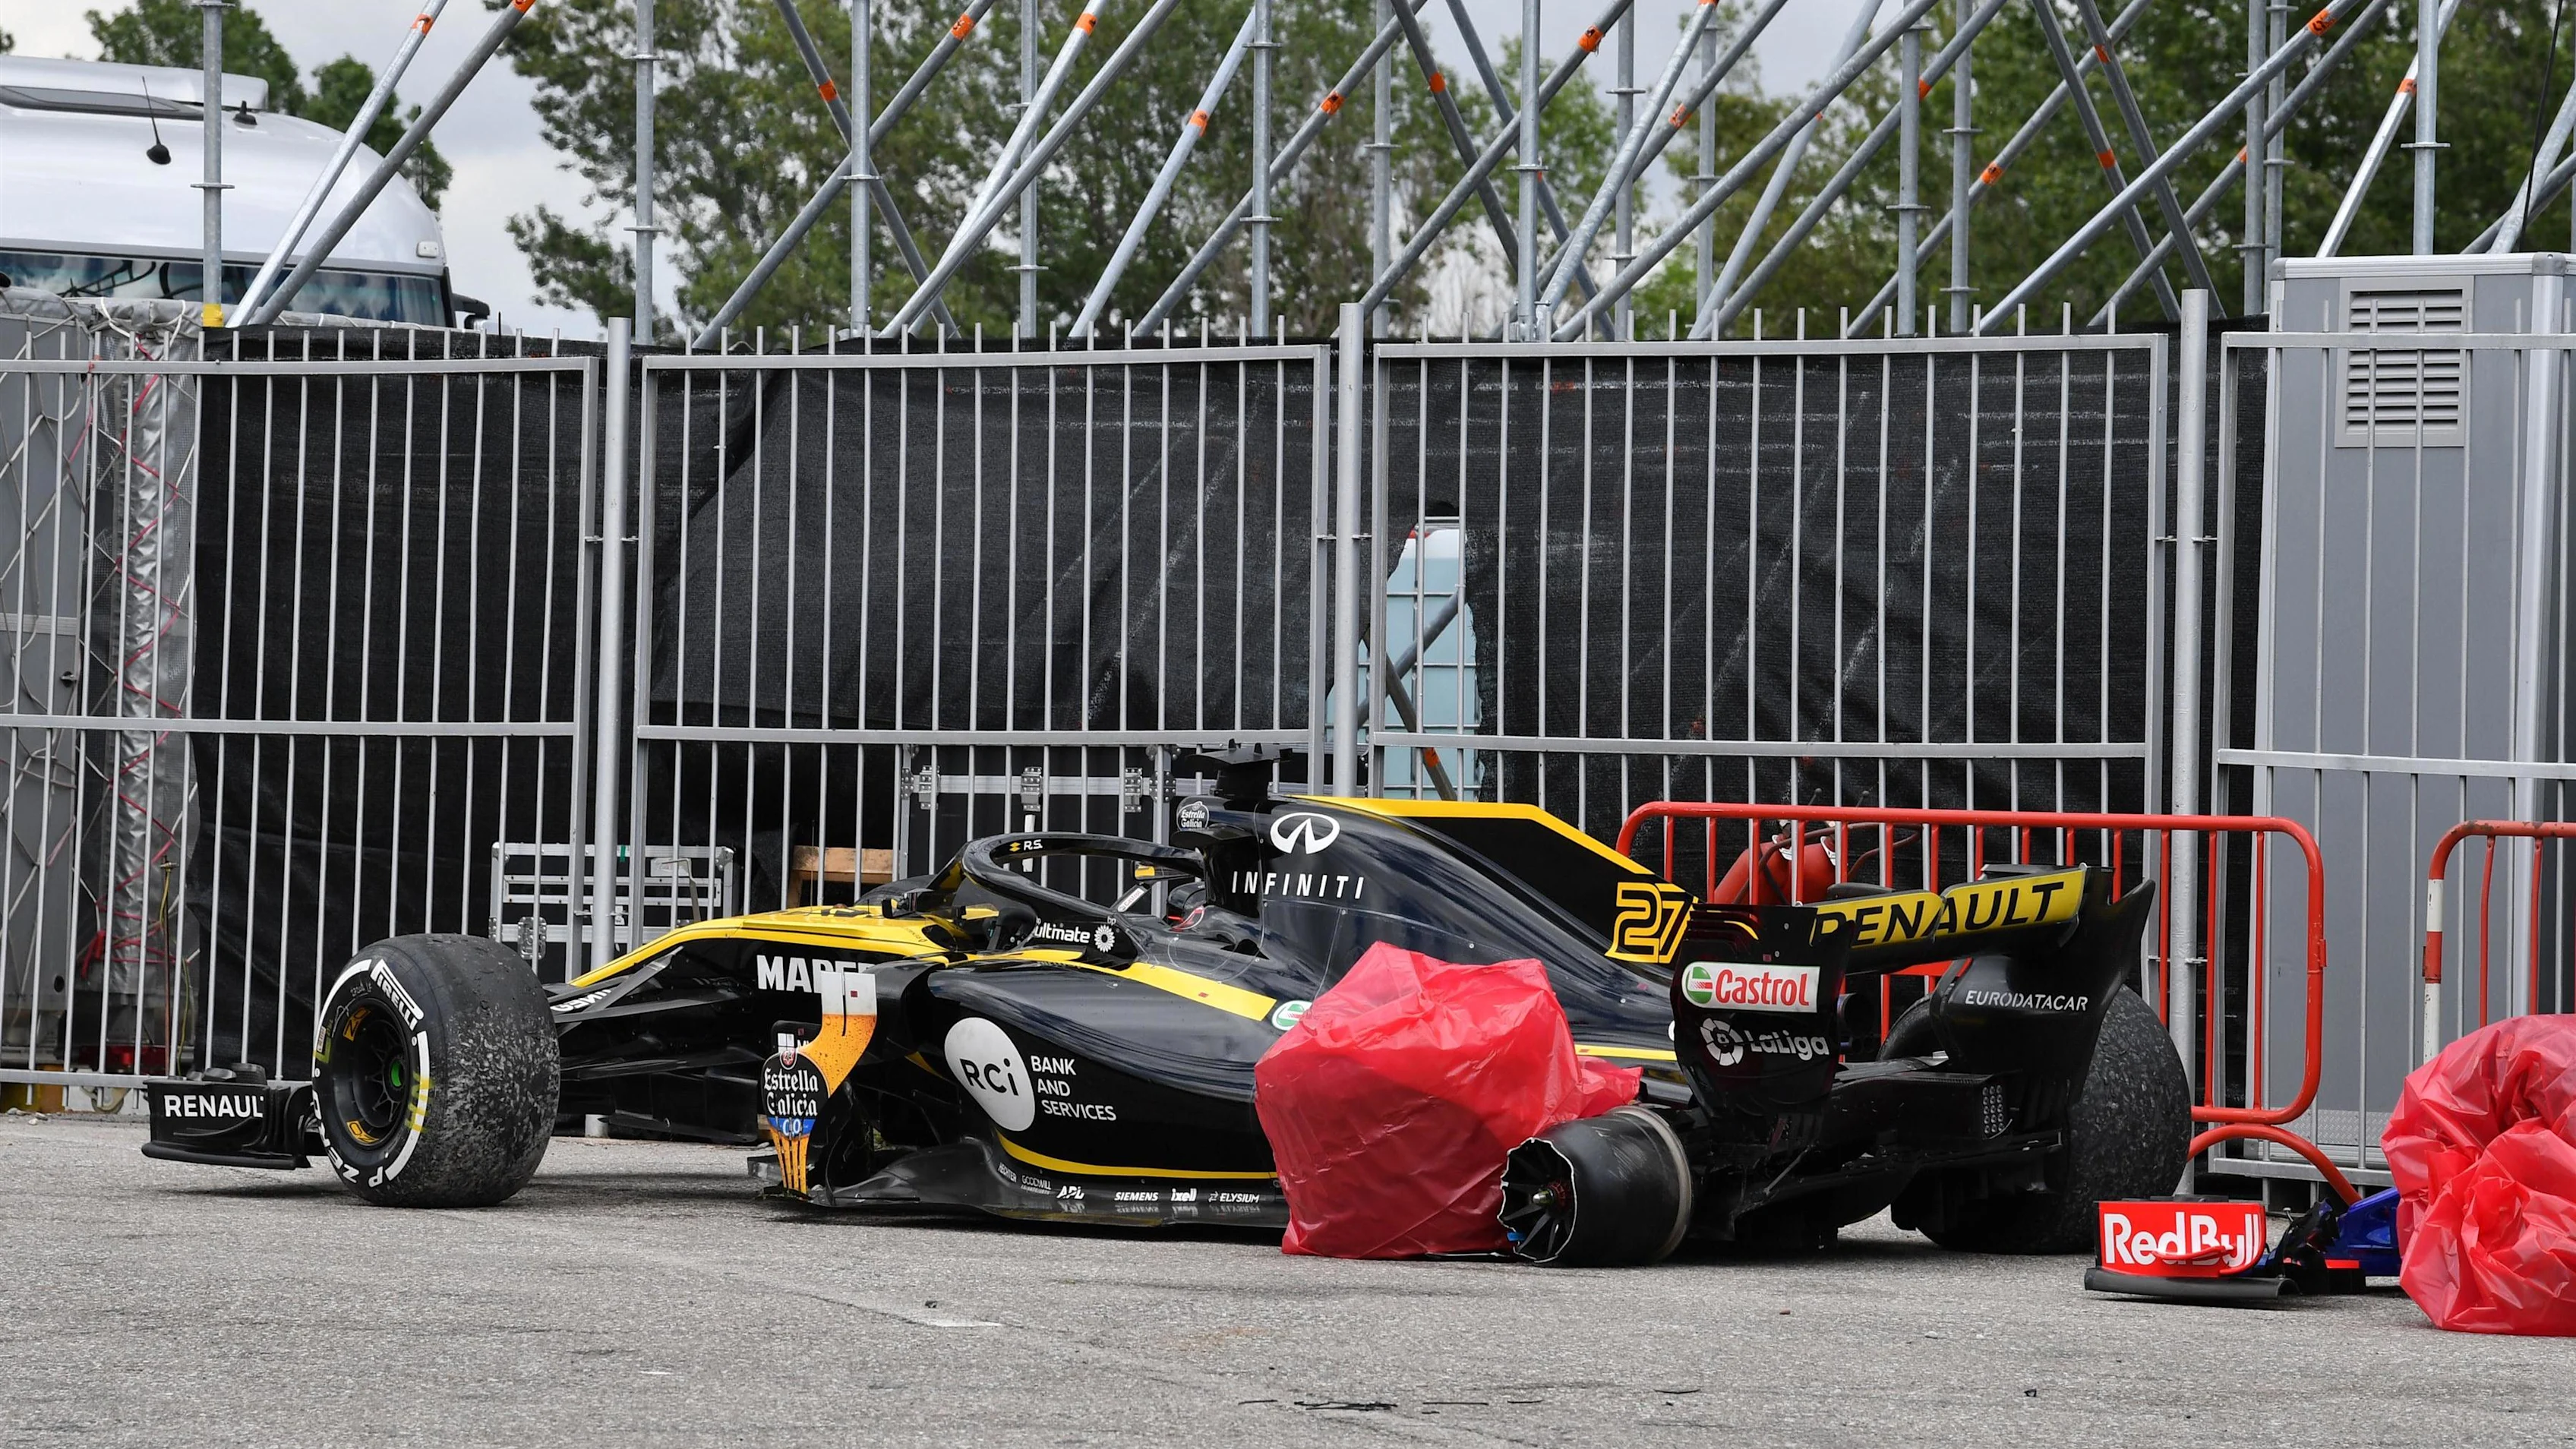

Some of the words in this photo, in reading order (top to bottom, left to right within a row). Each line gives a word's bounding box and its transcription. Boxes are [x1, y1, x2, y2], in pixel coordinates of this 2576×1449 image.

[1181, 810, 1205, 819] Estrella
[1181, 819, 1202, 828] Galicia
[1232, 871, 1364, 899] INFINITI
[1125, 890, 1141, 907] Castrol
[1107, 916, 1117, 925] bp
[1605, 882, 1698, 963] 27
[1812, 882, 2064, 946] RENAULT
[1034, 922, 1091, 943] ultimate
[370, 959, 424, 1031] PIRELLI
[1716, 969, 1809, 1006] Castrol
[1965, 990, 2088, 1011] EURODATACAR
[1745, 1030, 1829, 1061] LaLiga
[1031, 1056, 1076, 1075] BANK
[764, 1067, 819, 1092] Estrella
[960, 1058, 1019, 1096] RCi
[1037, 1078, 1070, 1097] AND
[164, 1094, 264, 1118] RENAUL
[767, 1091, 818, 1116] Galicia
[1041, 1100, 1116, 1121] SERVICES
[1021, 1175, 1052, 1190] GOODWILL
[1114, 1192, 1159, 1201] SIEMENS
[1220, 1192, 1260, 1204] ELYSIUM
